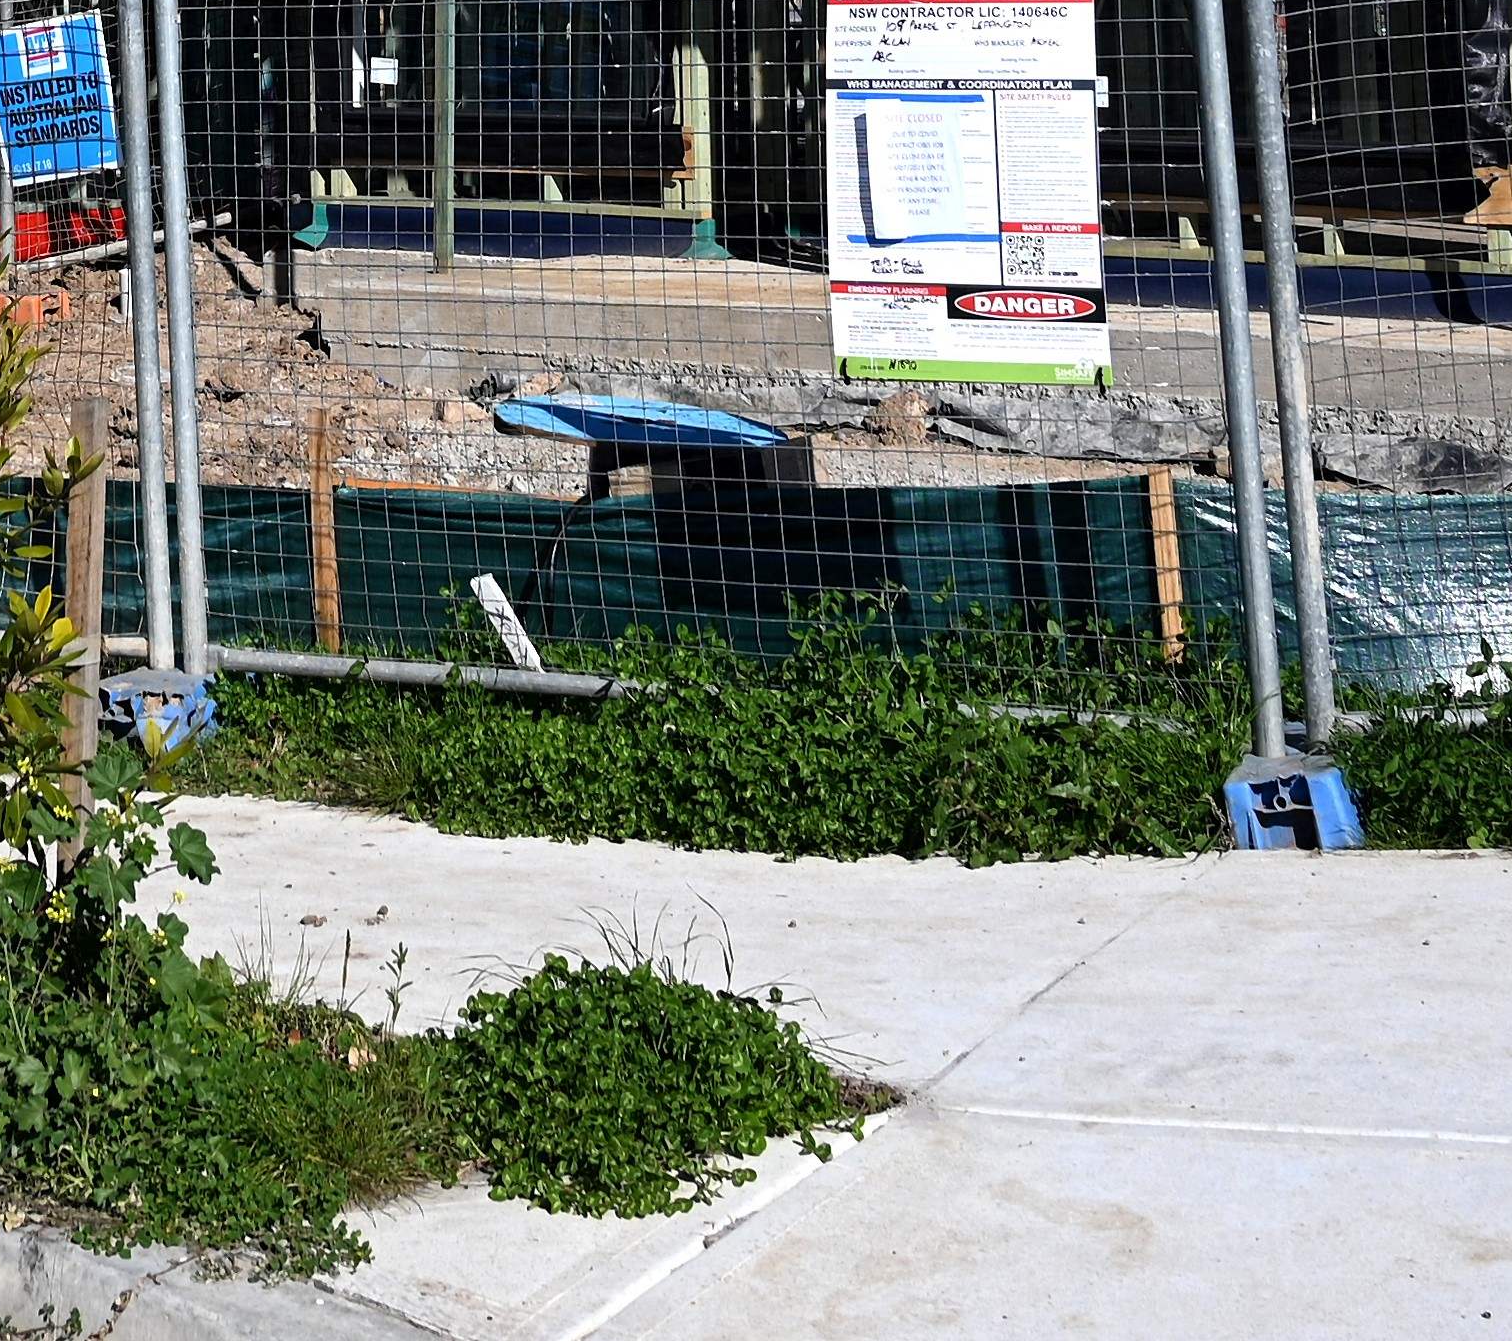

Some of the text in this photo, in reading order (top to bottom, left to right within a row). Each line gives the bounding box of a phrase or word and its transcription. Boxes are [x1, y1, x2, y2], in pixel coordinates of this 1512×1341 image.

[849, 6, 1068, 19] NSW CONTRACTOR LIC: 140646C
[79, 70, 98, 91] TO
[846, 80, 1073, 89] WHS MANAGEMENT & COORDINATION PLAN
[9, 92, 98, 128] AUSTRALIAN
[907, 113, 943, 124] CLOSED
[14, 115, 100, 149] STANDARDS
[1051, 224, 1083, 233] REPORT
[847, 286, 891, 294] EMERGENCY
[973, 295, 1076, 315] DANGER
